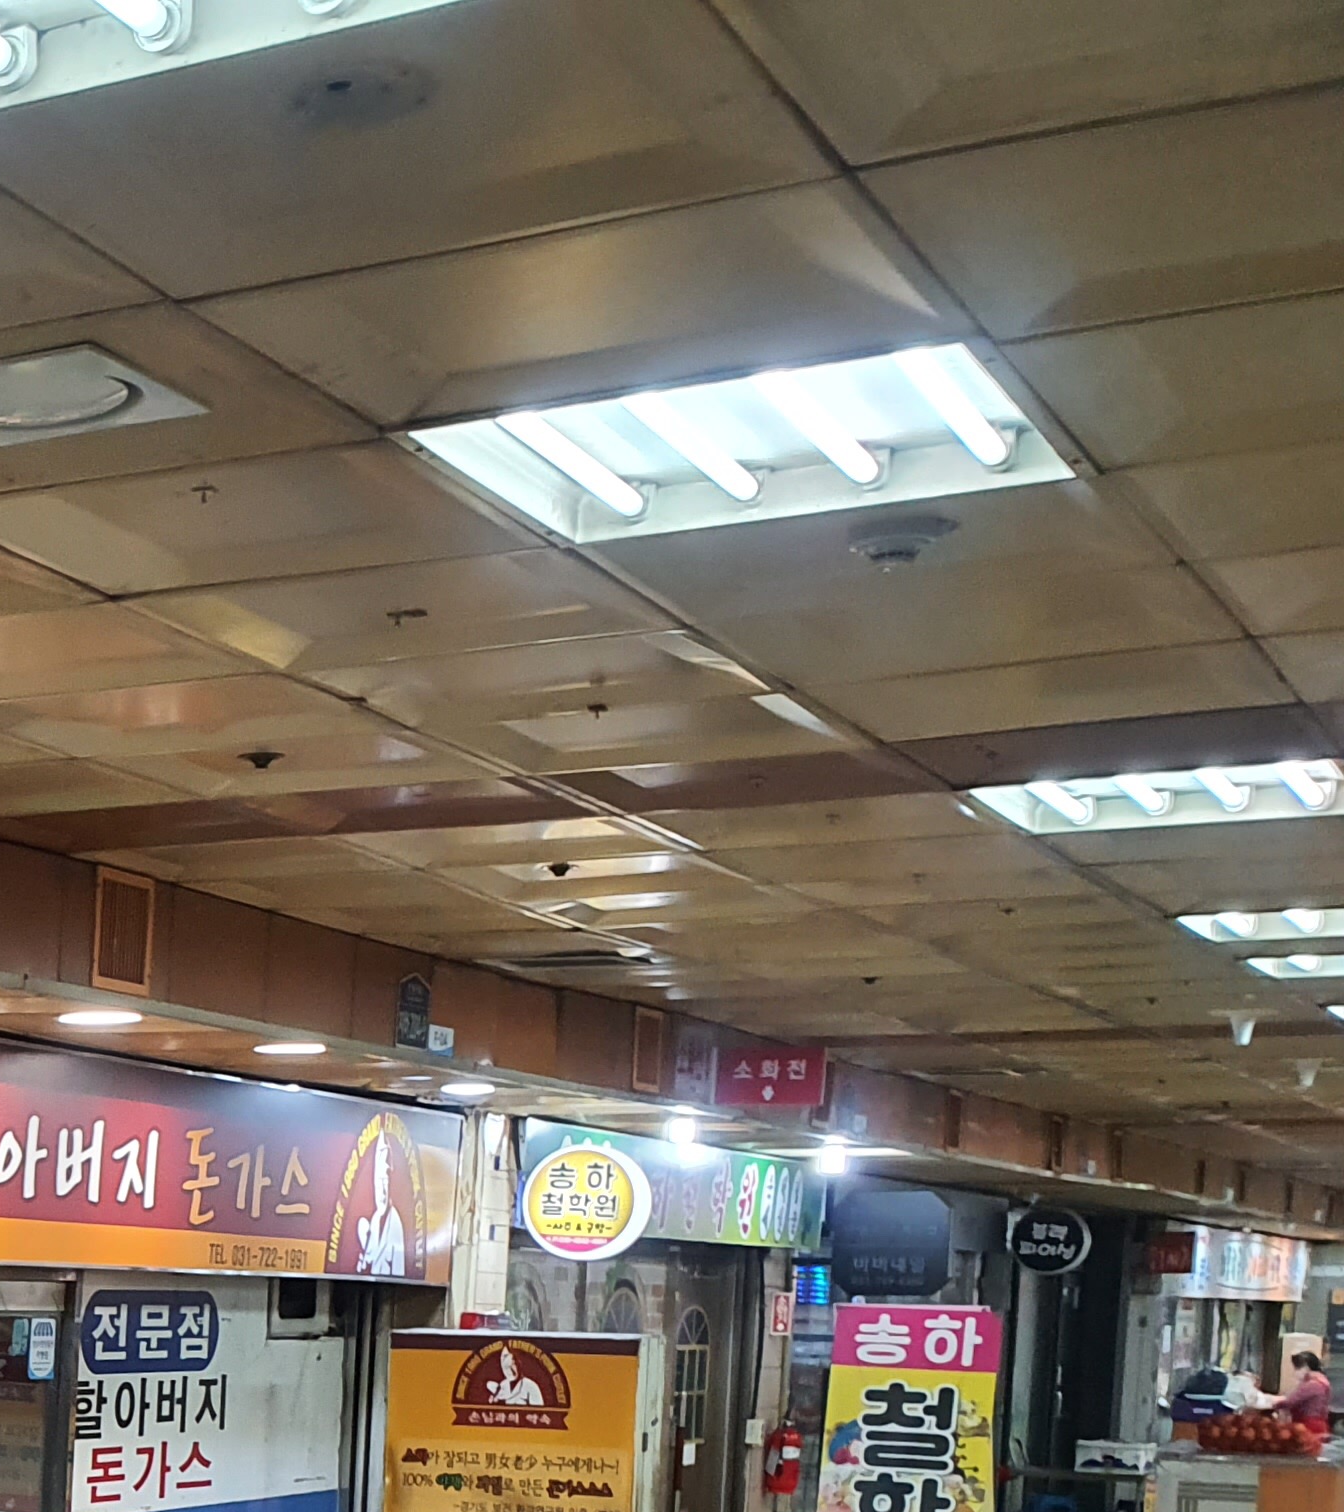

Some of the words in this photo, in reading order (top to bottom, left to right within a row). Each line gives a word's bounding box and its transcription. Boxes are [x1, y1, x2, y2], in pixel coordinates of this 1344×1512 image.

[732, 1058, 808, 1081] 소화전
[181, 1126, 311, 1227] 돈가스
[549, 1162, 615, 1191] 송하
[541, 1193, 619, 1220] 철학원
[232, 1244, 308, 1270] 031-722-1991
[91, 1303, 212, 1361] 전문점
[854, 1313, 983, 1367] 송하
[76, 1374, 228, 1440] 할아버지
[468, 1411, 520, 1425] 손님과의
[525, 1413, 552, 1426] 약속
[86, 1441, 213, 1503] 돈가스
[443, 1450, 480, 1468] 잘되고
[402, 1473, 433, 1488] 100%
[519, 1478, 544, 1496] 만든
